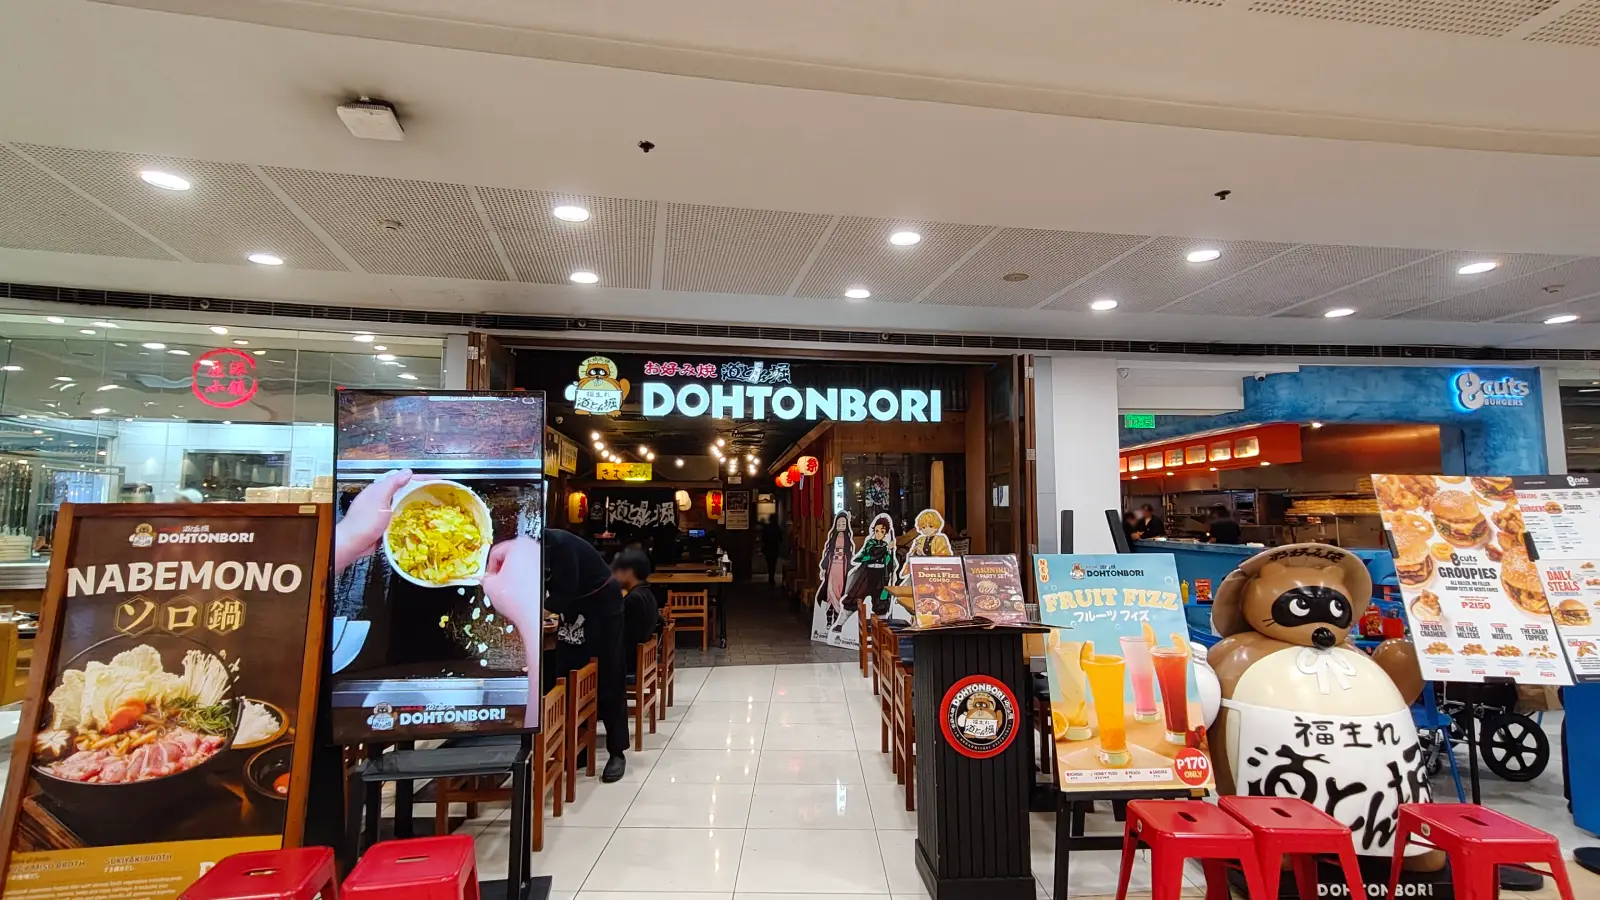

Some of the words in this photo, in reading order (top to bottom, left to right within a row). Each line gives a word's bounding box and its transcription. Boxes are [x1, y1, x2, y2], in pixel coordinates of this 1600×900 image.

[644, 361, 717, 378] お好み焼
[642, 382, 942, 423] DOHTONBORI
[1484, 398, 1523, 406] BURGERS
[158, 533, 255, 545] DOHTONBORI
[1450, 553, 1478, 566] 8cuts
[1039, 559, 1048, 581] NEW
[1087, 569, 1144, 577] DOHTONBORI
[1438, 566, 1498, 580] GROUPIES
[1546, 570, 1572, 581] DAILY
[67, 560, 303, 598] NABEMONO
[1547, 581, 1580, 592] STEALS
[1043, 588, 1118, 612] FRUIT
[1122, 588, 1179, 611] FIZZ
[121, 600, 242, 632] ソロ鍋
[1073, 610, 1117, 622] フルーツ
[1120, 610, 1150, 621] フィズ
[952, 683, 1006, 706] DOHTONBORI
[400, 707, 506, 726] DOHTONBORI
[1294, 716, 1401, 748] 福生れ
[1177, 756, 1207, 770] P170
[1184, 770, 1203, 778] ONLY
[31, 863, 53, 872] MISO
[56, 859, 86, 869] BROTH
[105, 855, 142, 865] SUKIYAKI
[142, 853, 172, 863] BROTH
